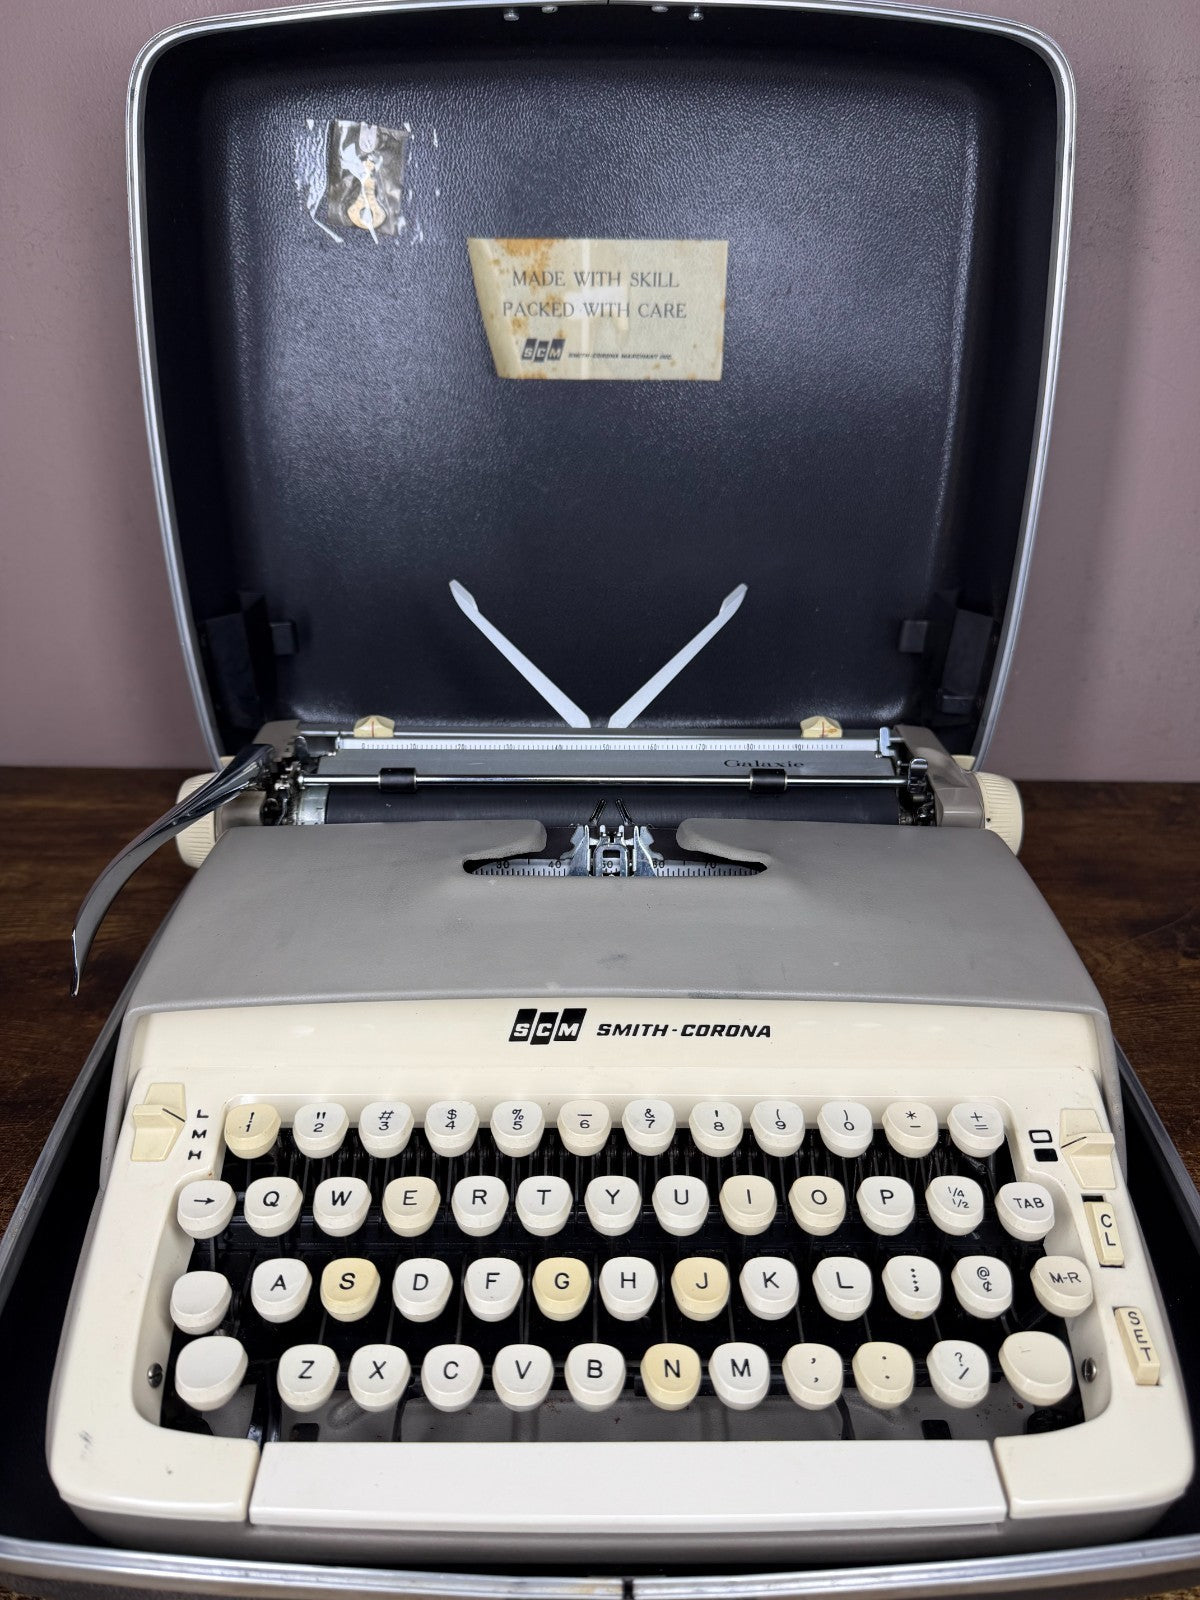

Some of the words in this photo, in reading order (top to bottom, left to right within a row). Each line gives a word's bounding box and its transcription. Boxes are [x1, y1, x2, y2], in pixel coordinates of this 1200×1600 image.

[513, 271, 566, 286] MADE
[574, 272, 621, 287] WITH
[630, 272, 680, 288] SKILL
[503, 302, 575, 317] PACKED
[583, 303, 630, 318] WITH
[638, 303, 687, 318] CARE
[521, 338, 566, 363] SCM
[723, 759, 805, 768] Galaxie
[548, 860, 562, 869] 40
[508, 1008, 588, 1045] SCM
[596, 1023, 771, 1038] SMITH-CORONA
[196, 1109, 210, 1119] L
[248, 1111, 255, 1124] !
[378, 1110, 395, 1121] #
[446, 1108, 457, 1121] $
[511, 1108, 525, 1121] %
[644, 1108, 656, 1119] &
[776, 1108, 781, 1121] (
[843, 1109, 849, 1121] )
[970, 1111, 983, 1122] +
[246, 1123, 251, 1133] 1
[313, 1122, 325, 1133] 2
[378, 1121, 390, 1131] 3
[444, 1120, 456, 1130] 4
[512, 1120, 523, 1131] 5
[579, 1119, 590, 1129] 6
[645, 1118, 656, 1129] 7
[713, 1121, 725, 1132] 8
[775, 1120, 787, 1130] 9
[843, 1121, 855, 1131] 0
[191, 1129, 208, 1139] M
[187, 1150, 202, 1161] H
[262, 1190, 280, 1208] Q
[331, 1190, 353, 1207] W
[402, 1189, 418, 1206] E
[471, 1189, 488, 1205] R
[536, 1189, 552, 1206] T
[605, 1189, 620, 1205] Y
[674, 1188, 689, 1206] U
[810, 1189, 828, 1206] O
[879, 1189, 894, 1205] P
[1012, 1197, 1045, 1209] TAB
[339, 1272, 356, 1291] S
[485, 1272, 501, 1290] F
[554, 1272, 570, 1290] G
[620, 1271, 636, 1289] H
[695, 1272, 709, 1290] J
[762, 1271, 780, 1289] K
[835, 1271, 854, 1289] L
[976, 1266, 990, 1281] @
[1049, 1271, 1082, 1284] M-R
[270, 1274, 287, 1292] A
[412, 1273, 429, 1291] D
[982, 1280, 993, 1293] ¢
[954, 1351, 964, 1367] ?
[298, 1360, 315, 1380] Z
[368, 1360, 387, 1380] X
[443, 1360, 459, 1380] C
[515, 1359, 532, 1380] V
[586, 1358, 603, 1379] B
[664, 1358, 681, 1379] N
[730, 1358, 752, 1378] M
[958, 1367, 970, 1380] /
